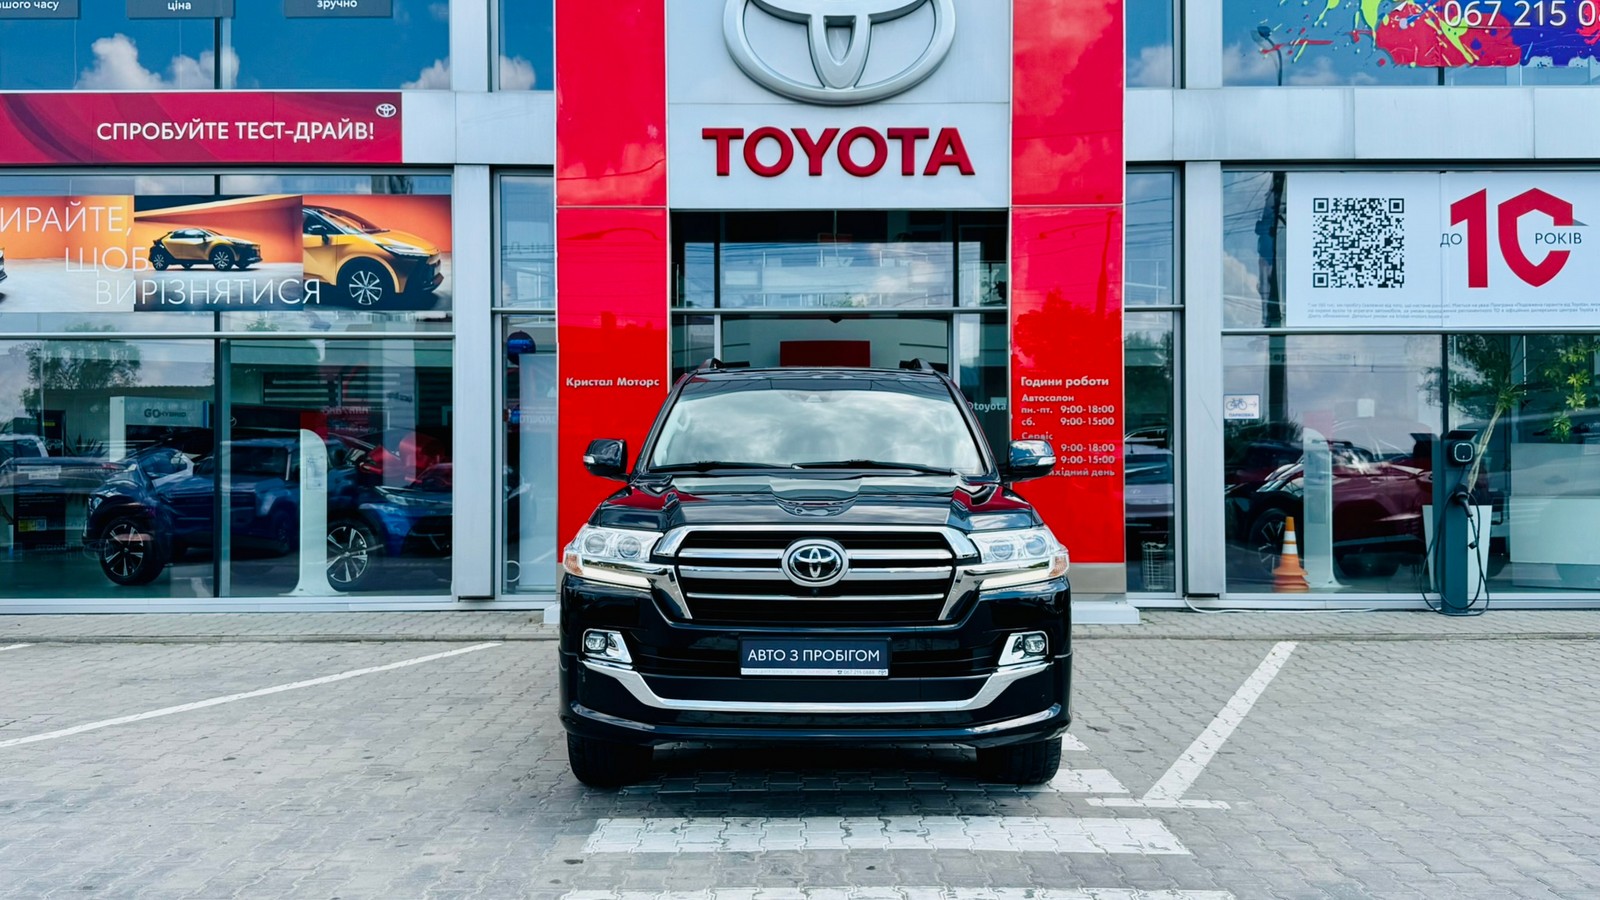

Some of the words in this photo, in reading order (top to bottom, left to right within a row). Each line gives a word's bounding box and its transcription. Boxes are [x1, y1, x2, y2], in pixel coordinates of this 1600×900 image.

[34, 1, 60, 11] часу
[167, 0, 192, 11] ціна
[317, 0, 358, 10] зручно
[1444, 0, 1501, 27] 067
[1514, 0, 1567, 27] 215
[1578, 0, 1600, 27] 0
[96, 118, 229, 141] СПРОБУЙТЕ
[235, 119, 374, 142] ТЕСТ-ДРАЙВ!
[702, 126, 976, 177] TOYOTA
[1440, 233, 1463, 248] ДО
[1534, 232, 1582, 245] РОКІВ
[65, 246, 149, 278] ЩОБ
[95, 278, 322, 305] ВИРІЗНЯТИСЯ
[566, 377, 613, 388] Кристал
[617, 377, 660, 388] Моторс
[1020, 376, 1062, 387] Години
[1065, 376, 1109, 389] роботи
[1021, 394, 1075, 403] Автосалон
[1060, 405, 1115, 414] 9:00-18:00
[1021, 417, 1036, 426] сб.
[1060, 417, 1115, 426] 9:00-15:00
[1060, 444, 1115, 452] 9:00-18:00
[1060, 456, 1115, 464] 9:00-15:00
[1048, 467, 1089, 477] ихідний
[1091, 469, 1115, 477] день
[747, 649, 786, 662] АВТО
[789, 649, 799, 662] З
[803, 649, 880, 662] ПРОБІГОМ
